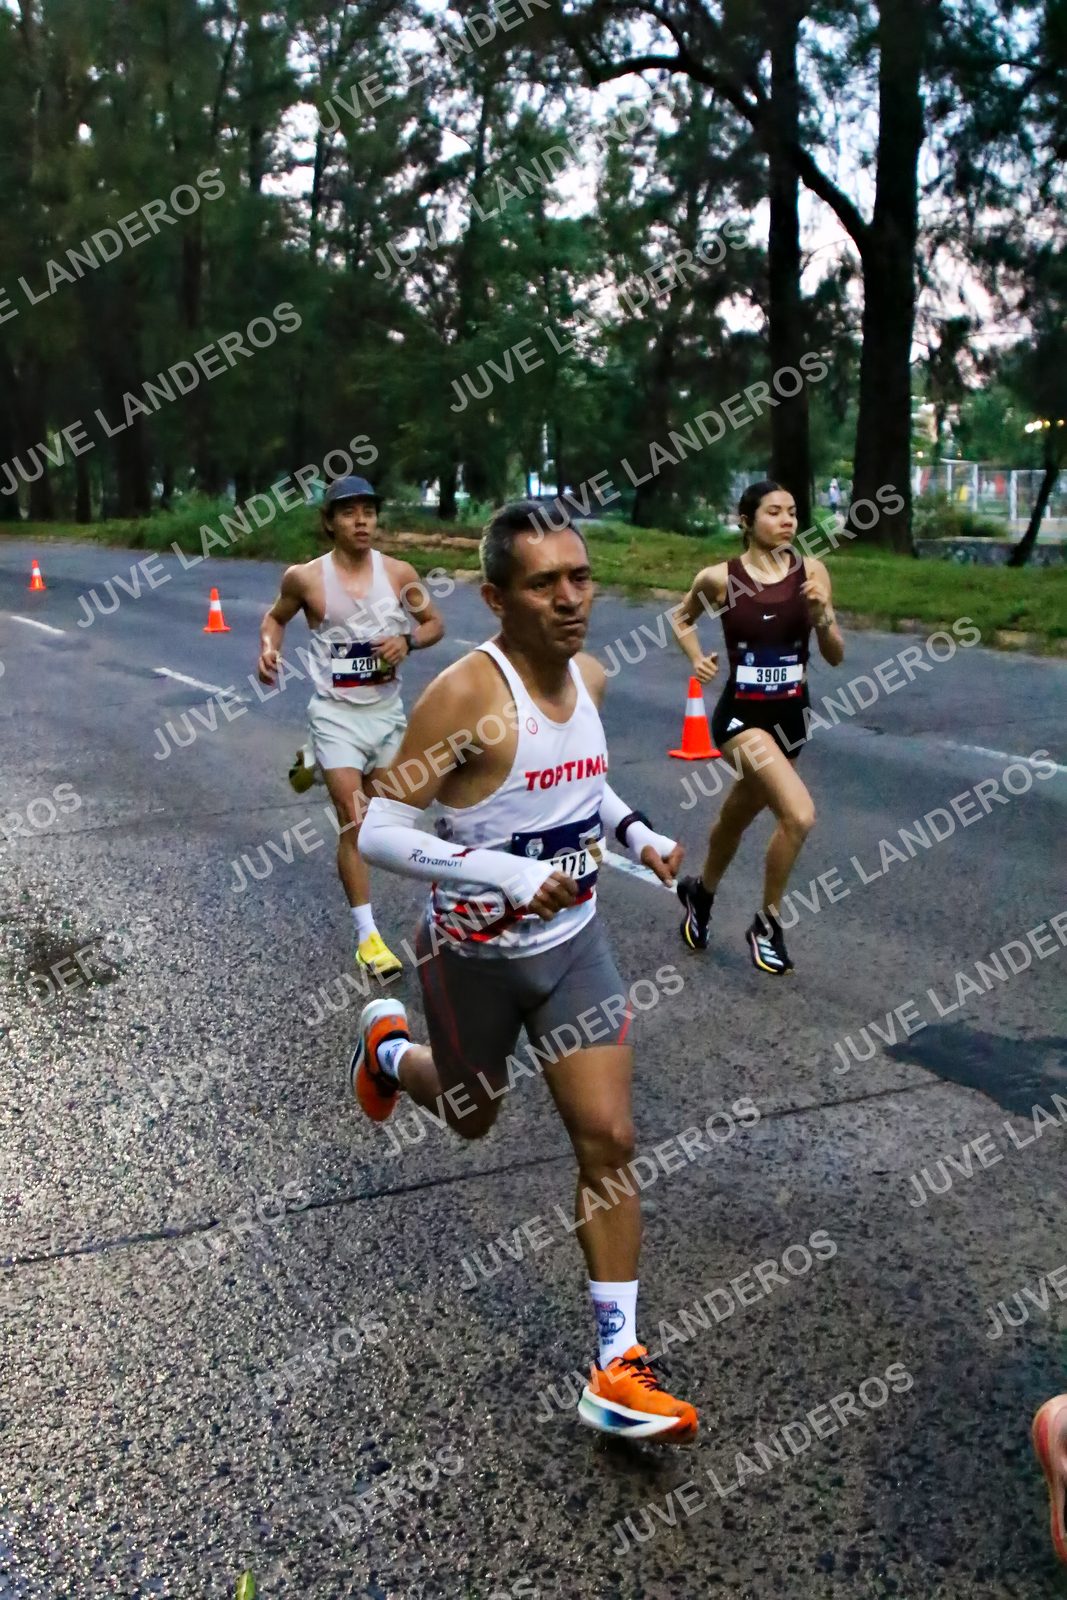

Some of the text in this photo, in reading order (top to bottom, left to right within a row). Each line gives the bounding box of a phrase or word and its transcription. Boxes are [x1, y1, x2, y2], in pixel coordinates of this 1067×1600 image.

[351, 657, 378, 672] 4201
[756, 668, 787, 683] 3906
[550, 852, 587, 877] 178
